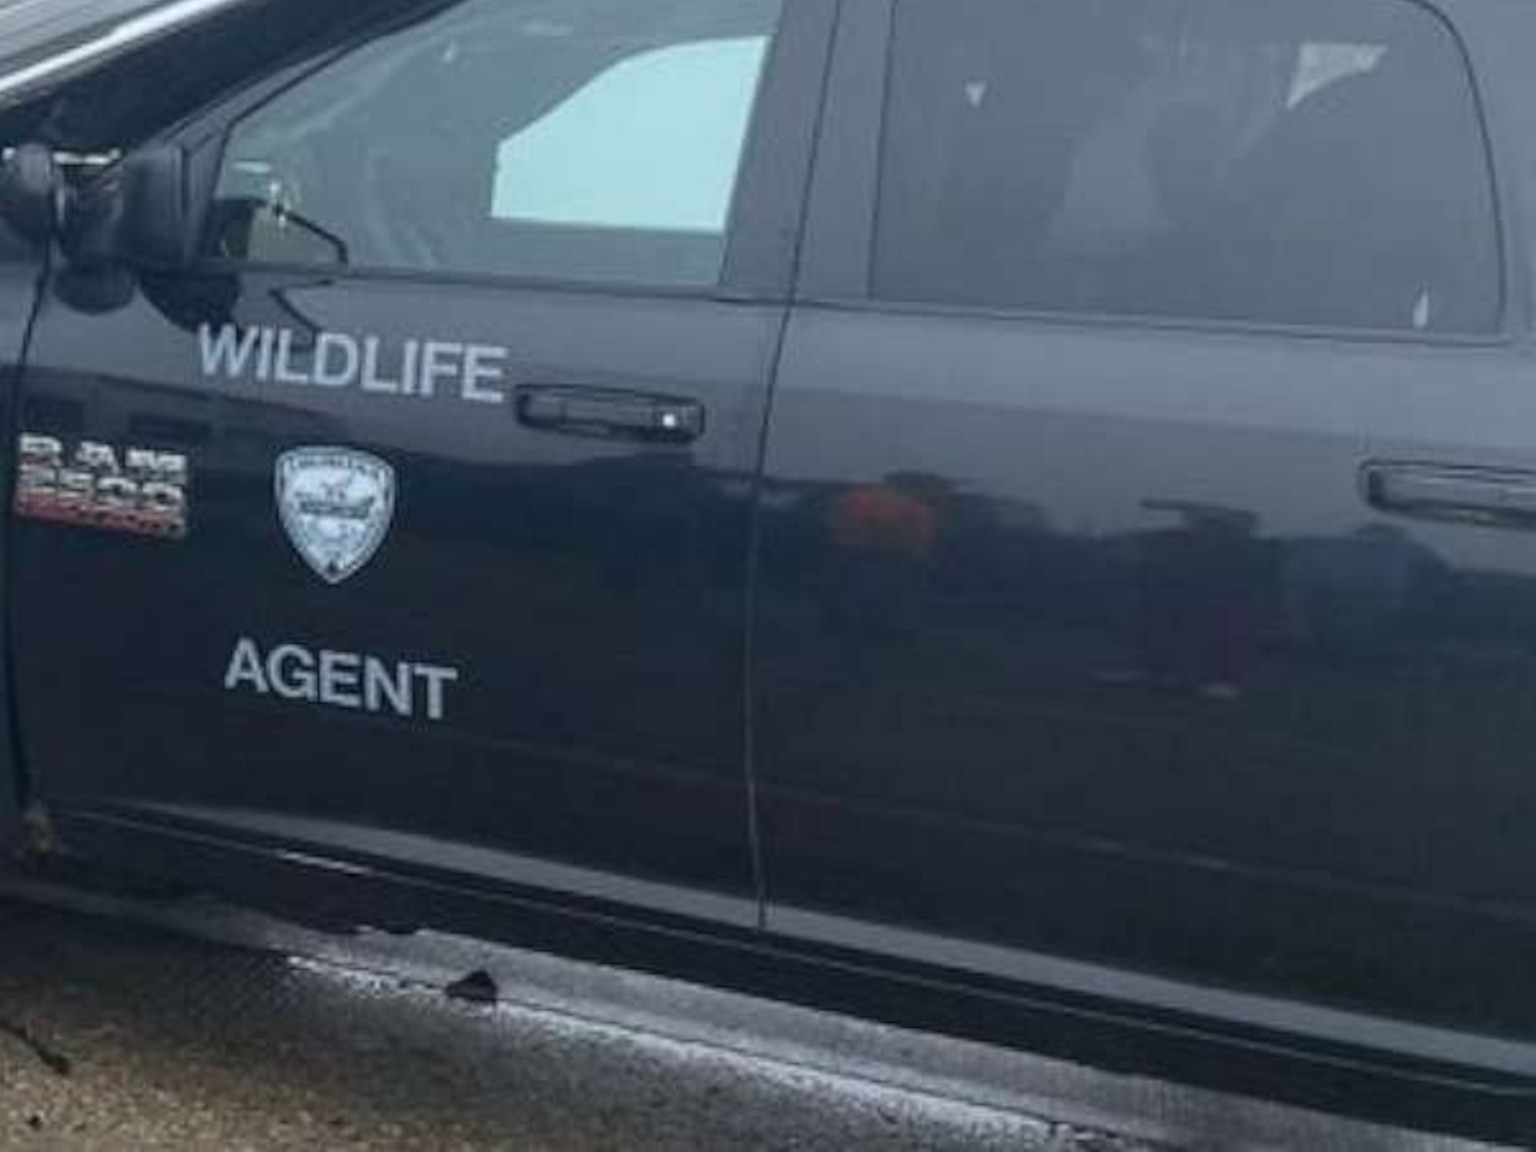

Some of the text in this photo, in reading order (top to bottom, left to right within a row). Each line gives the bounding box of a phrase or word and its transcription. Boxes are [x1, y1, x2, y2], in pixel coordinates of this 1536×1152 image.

[198, 322, 507, 403] WILDLIFE
[19, 432, 186, 485] RAM
[224, 636, 459, 720] AGENT
